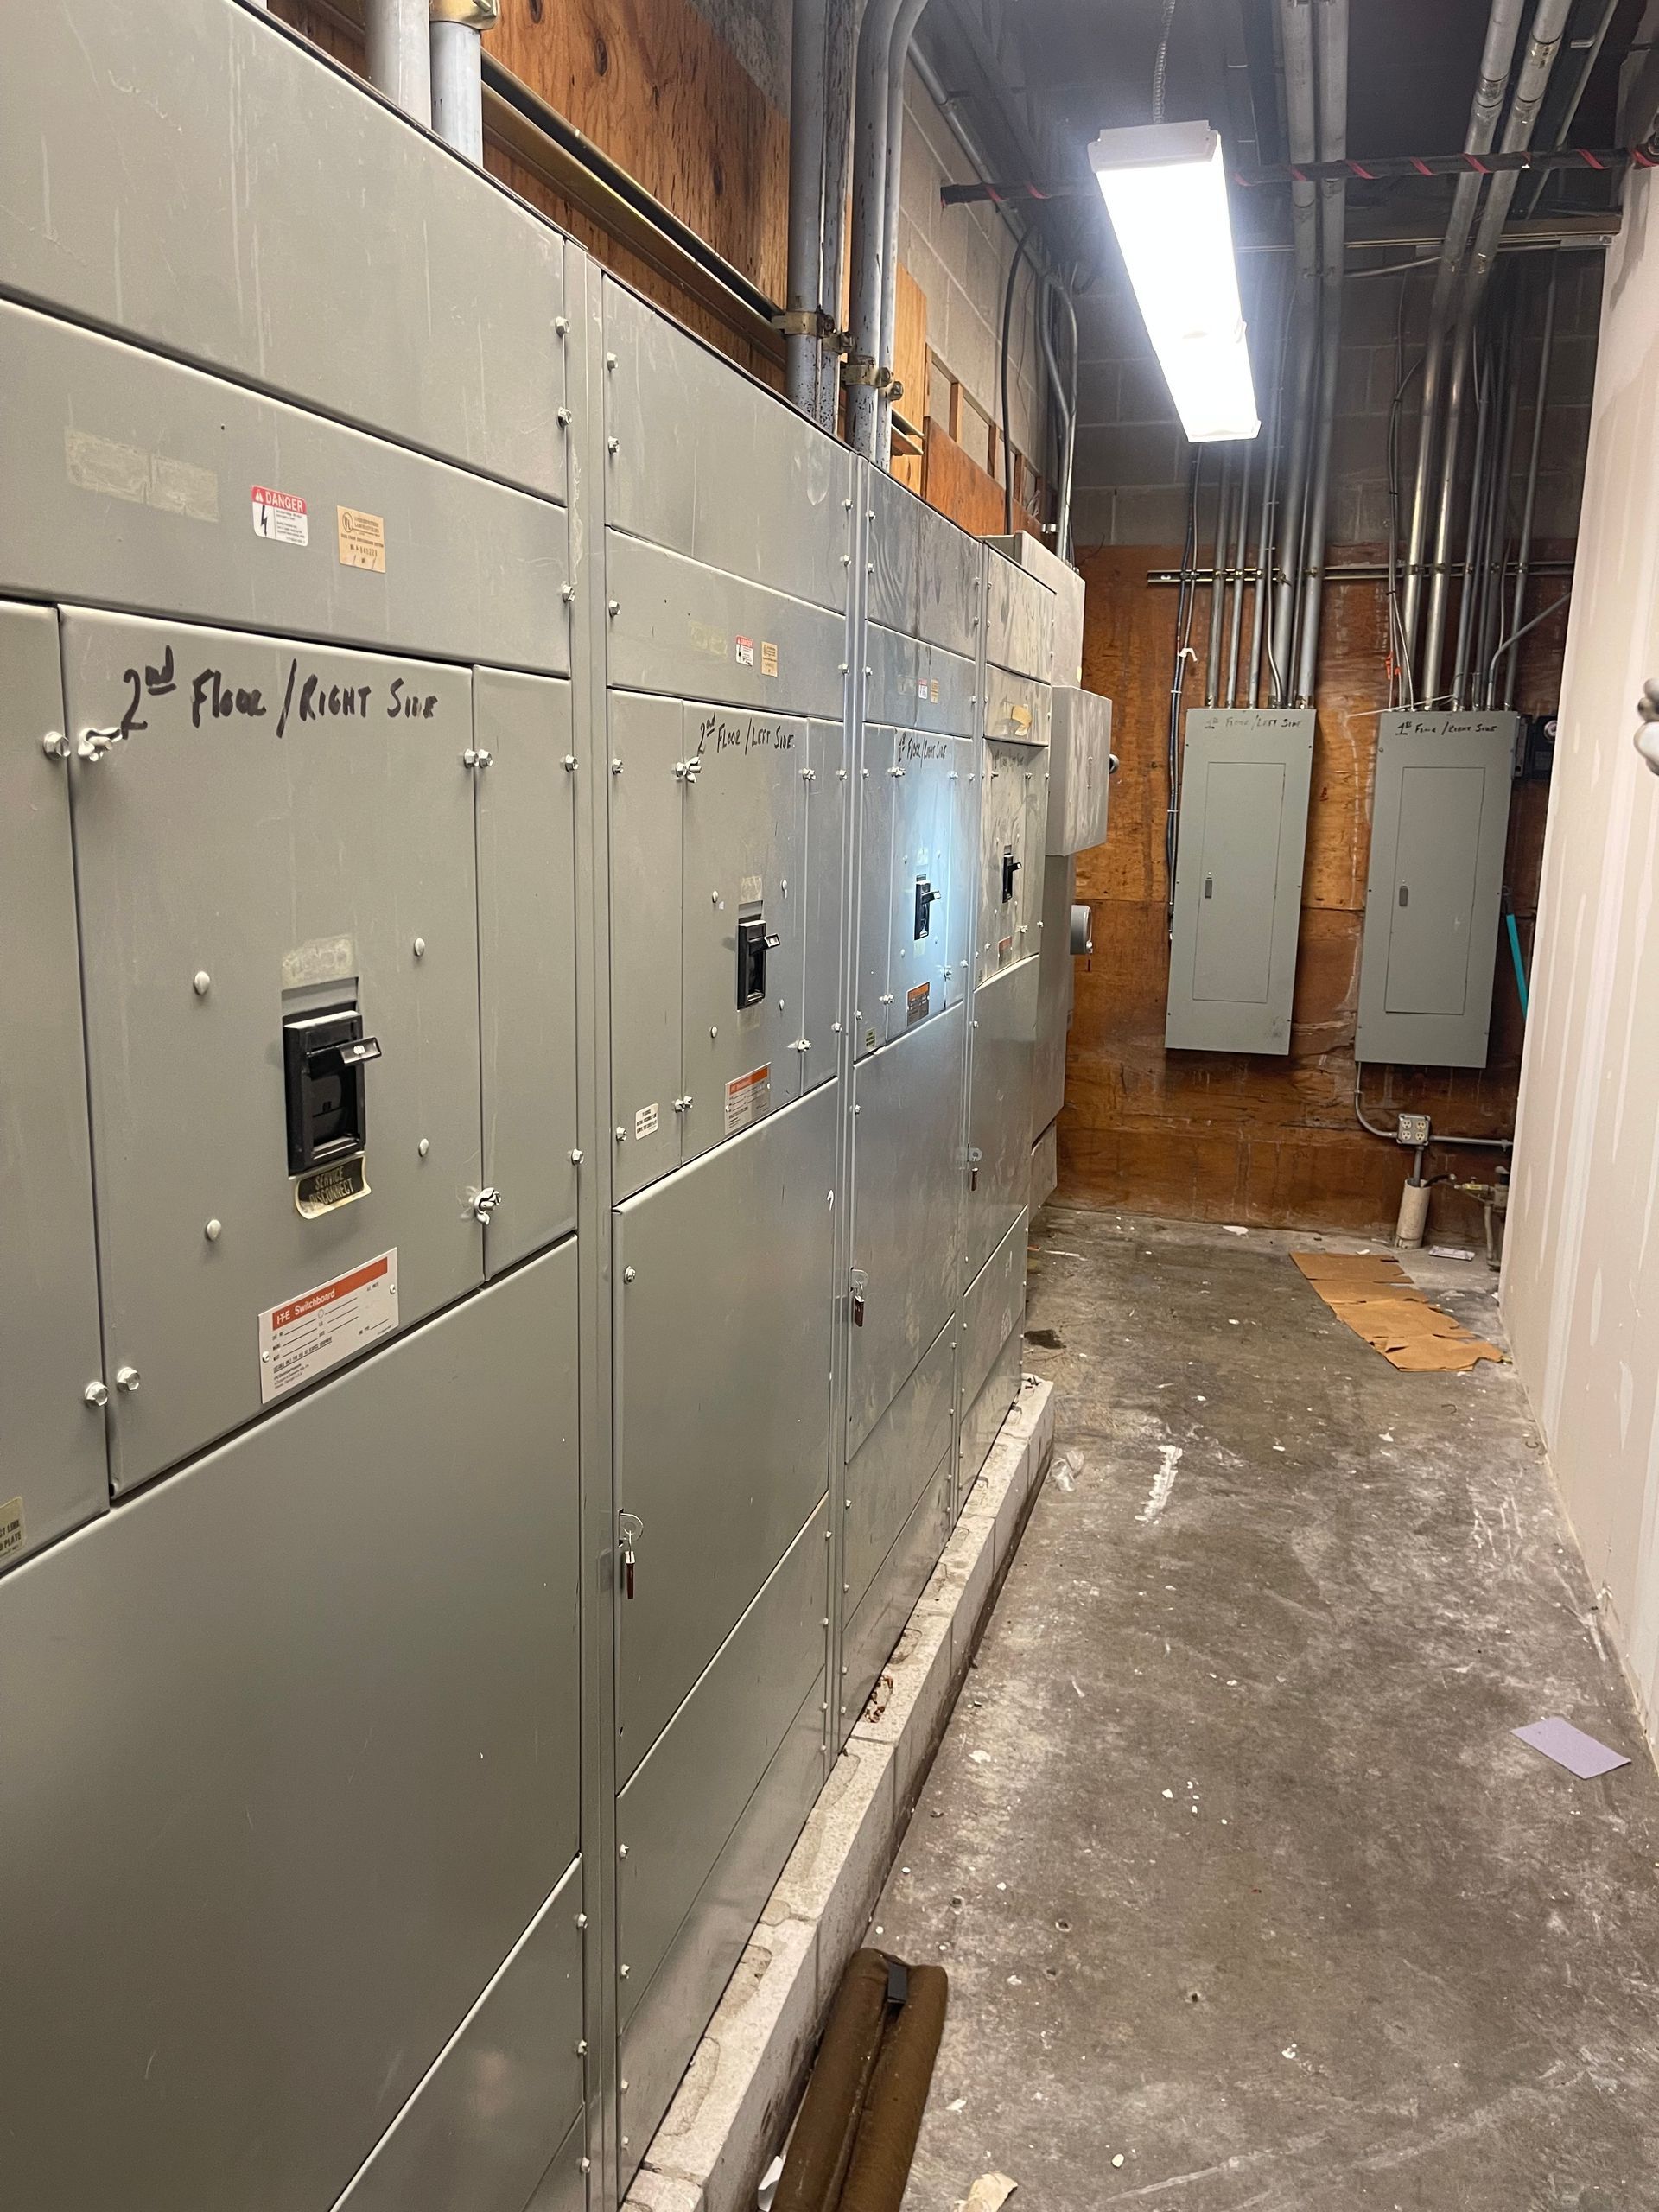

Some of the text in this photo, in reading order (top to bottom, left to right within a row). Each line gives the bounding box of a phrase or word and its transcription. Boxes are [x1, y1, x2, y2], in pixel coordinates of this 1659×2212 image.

[265, 491, 303, 512] DANGER
[315, 1166, 345, 1190] SERVICE
[309, 1178, 354, 1207] DISCONNECT
[295, 1288, 335, 1316] Switchboard
